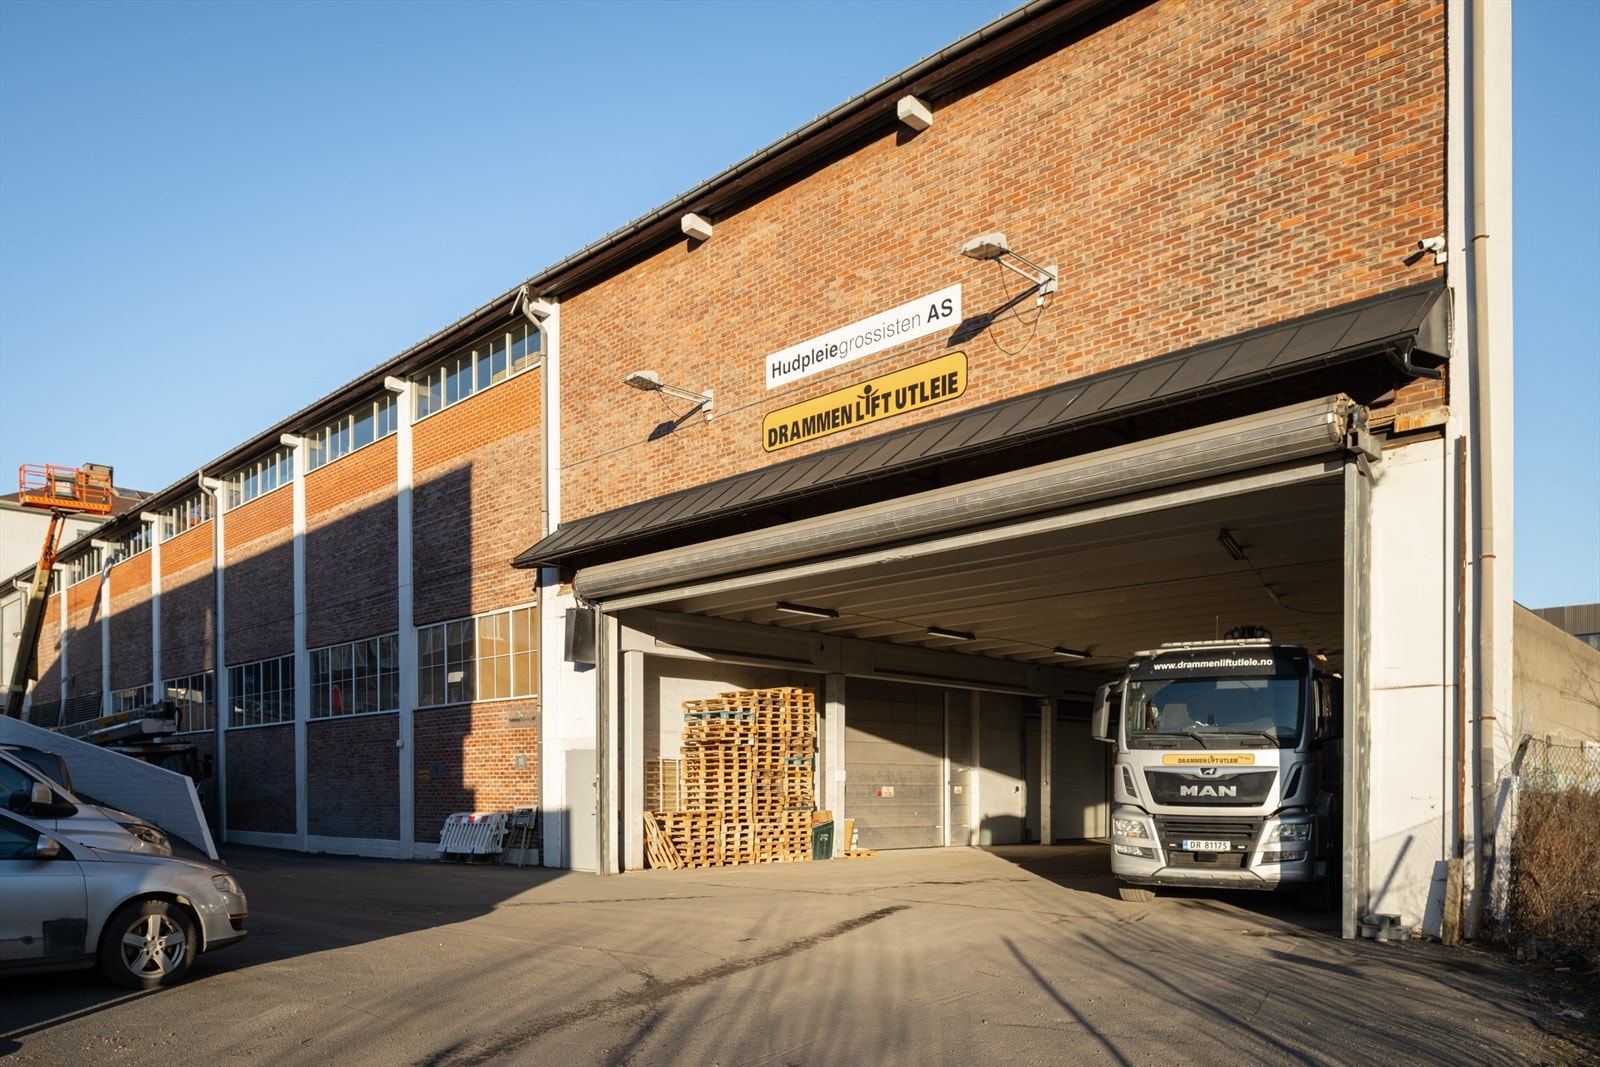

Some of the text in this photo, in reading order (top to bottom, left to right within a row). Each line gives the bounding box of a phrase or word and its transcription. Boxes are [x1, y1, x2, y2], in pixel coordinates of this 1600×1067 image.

[772, 298, 953, 378] Hudpleiegrossisten AS
[768, 371, 959, 447] DRAMMEN LIFT UTLEIE
[1153, 658, 1273, 670] www.drammenliftutleie.no
[1180, 785, 1237, 797] MAN
[1190, 841, 1201, 849] DR
